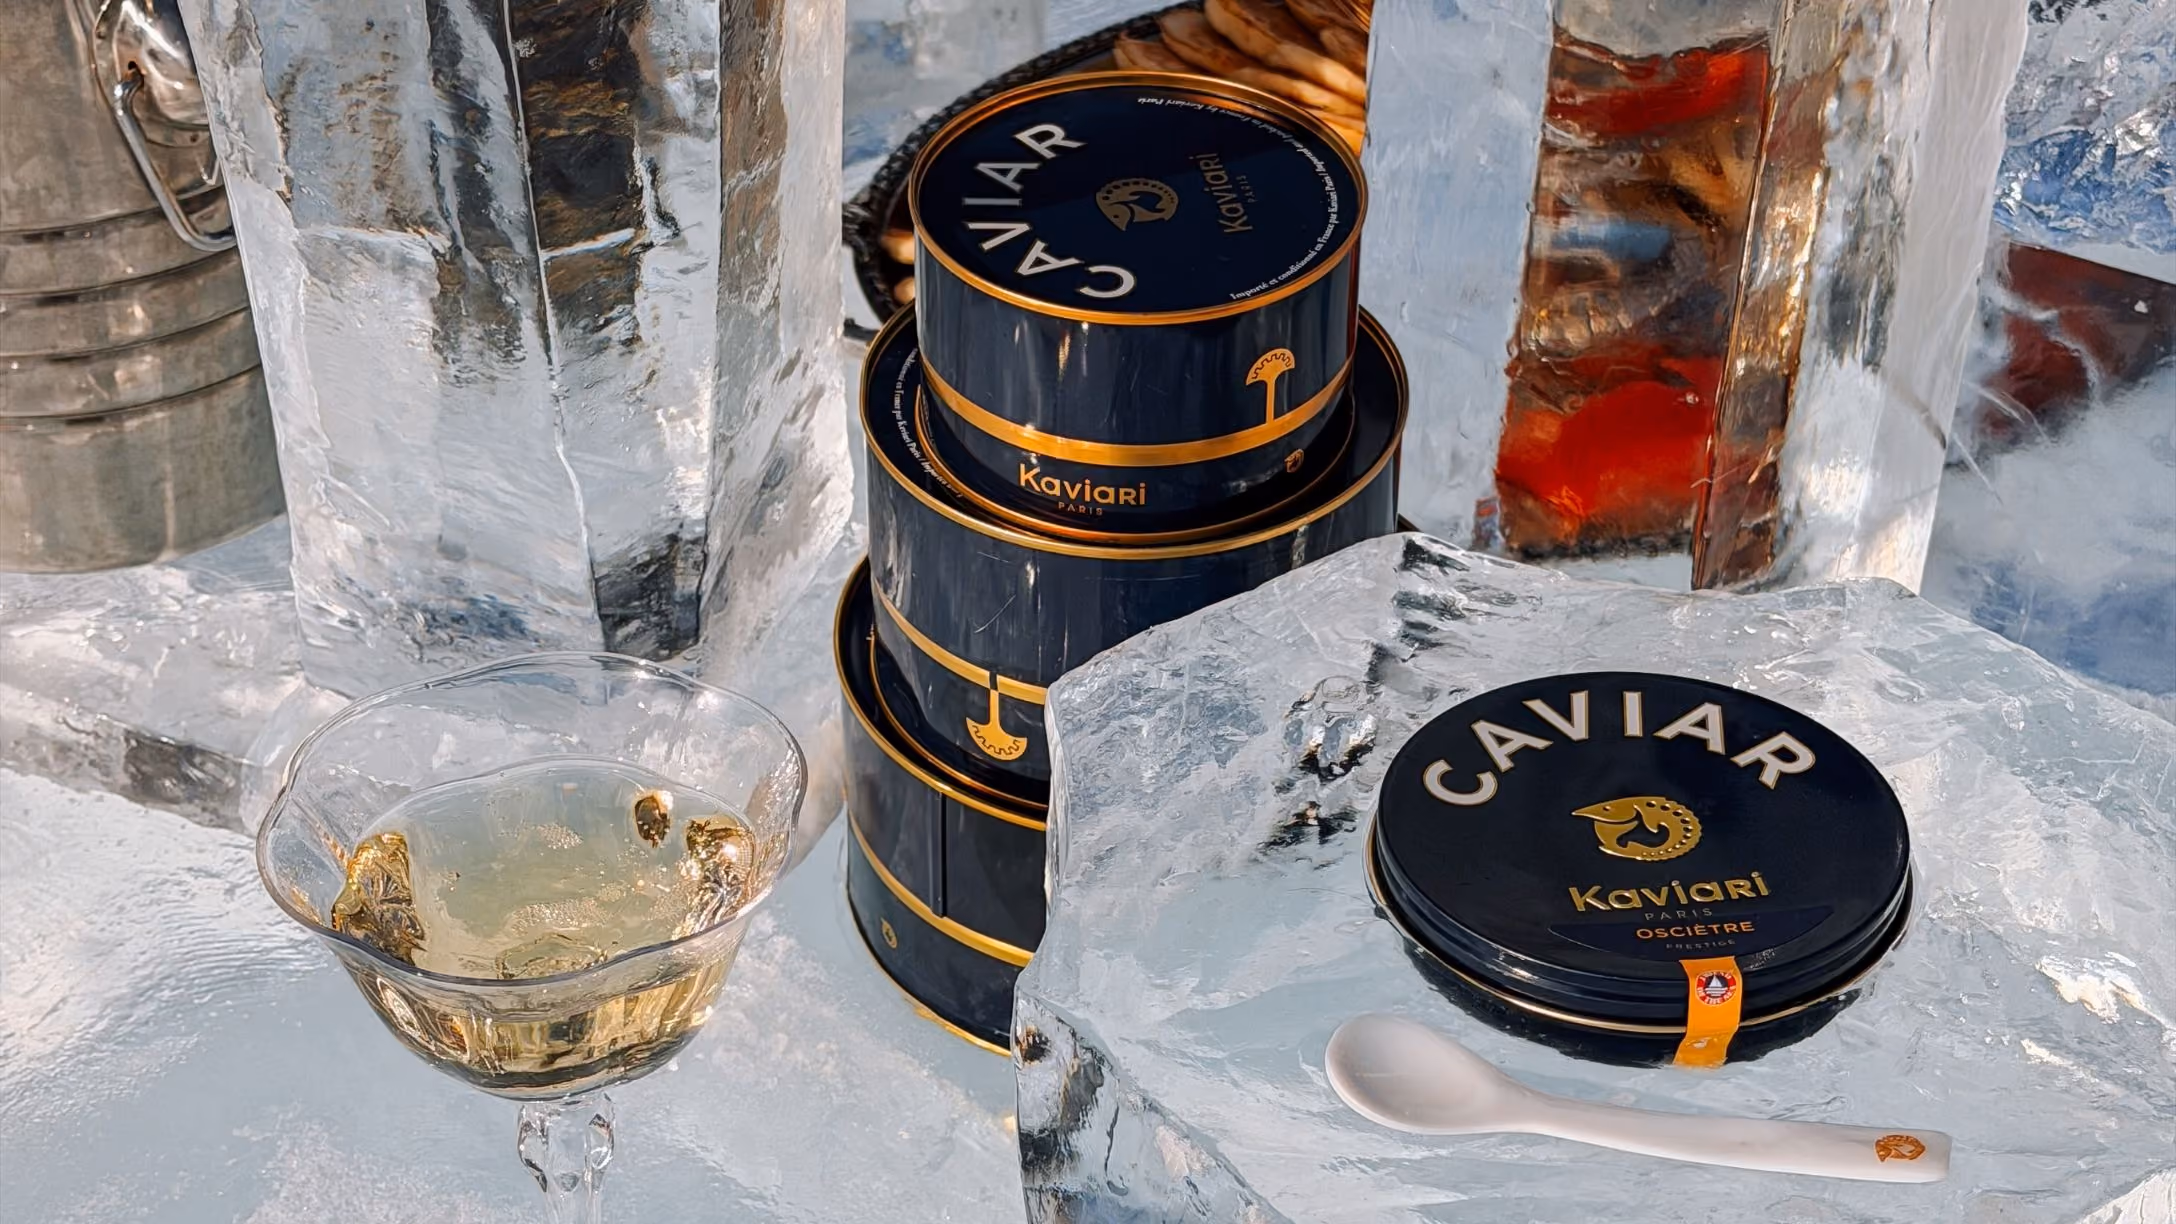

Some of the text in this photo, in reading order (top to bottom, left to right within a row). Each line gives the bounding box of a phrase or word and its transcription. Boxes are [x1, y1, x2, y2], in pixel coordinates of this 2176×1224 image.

[962, 122, 1138, 298] CAVIAR
[1058, 501, 1103, 516] PARIS
[1423, 690, 1816, 806] CAVIAR
[1645, 907, 1713, 921] PARIS
[1636, 921, 1756, 939] OSCIÈTRE
[1666, 938, 1736, 951] PRESTIGE
